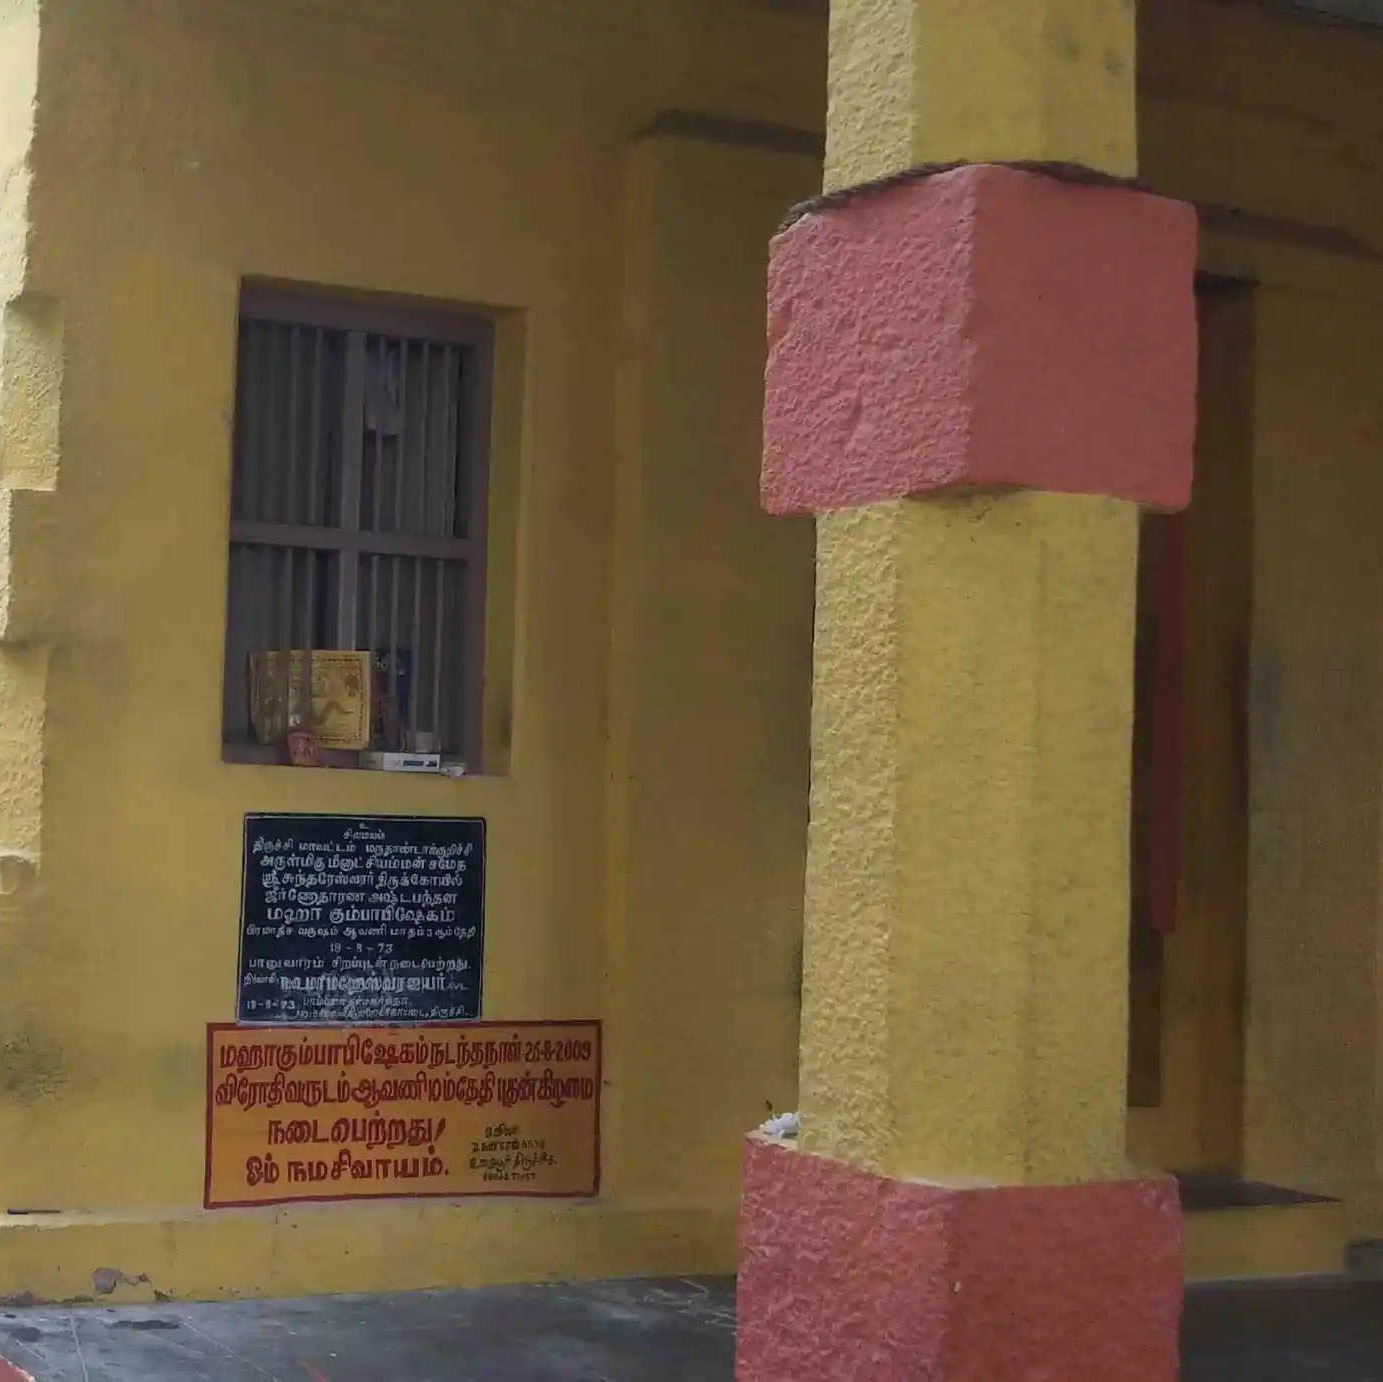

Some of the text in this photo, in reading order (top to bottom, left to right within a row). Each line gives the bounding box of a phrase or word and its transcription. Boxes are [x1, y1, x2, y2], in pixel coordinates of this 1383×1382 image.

[252, 836, 294, 855] திருச்சி
[298, 840, 356, 853] மாவட்டம்
[259, 853, 326, 872] அருள்மிகு
[428, 858, 467, 873] சமேத
[267, 905, 456, 925] மஹா கும்பாபிஷேகம்
[343, 923, 387, 938] ஆவணி
[390, 925, 425, 940] மாதம்
